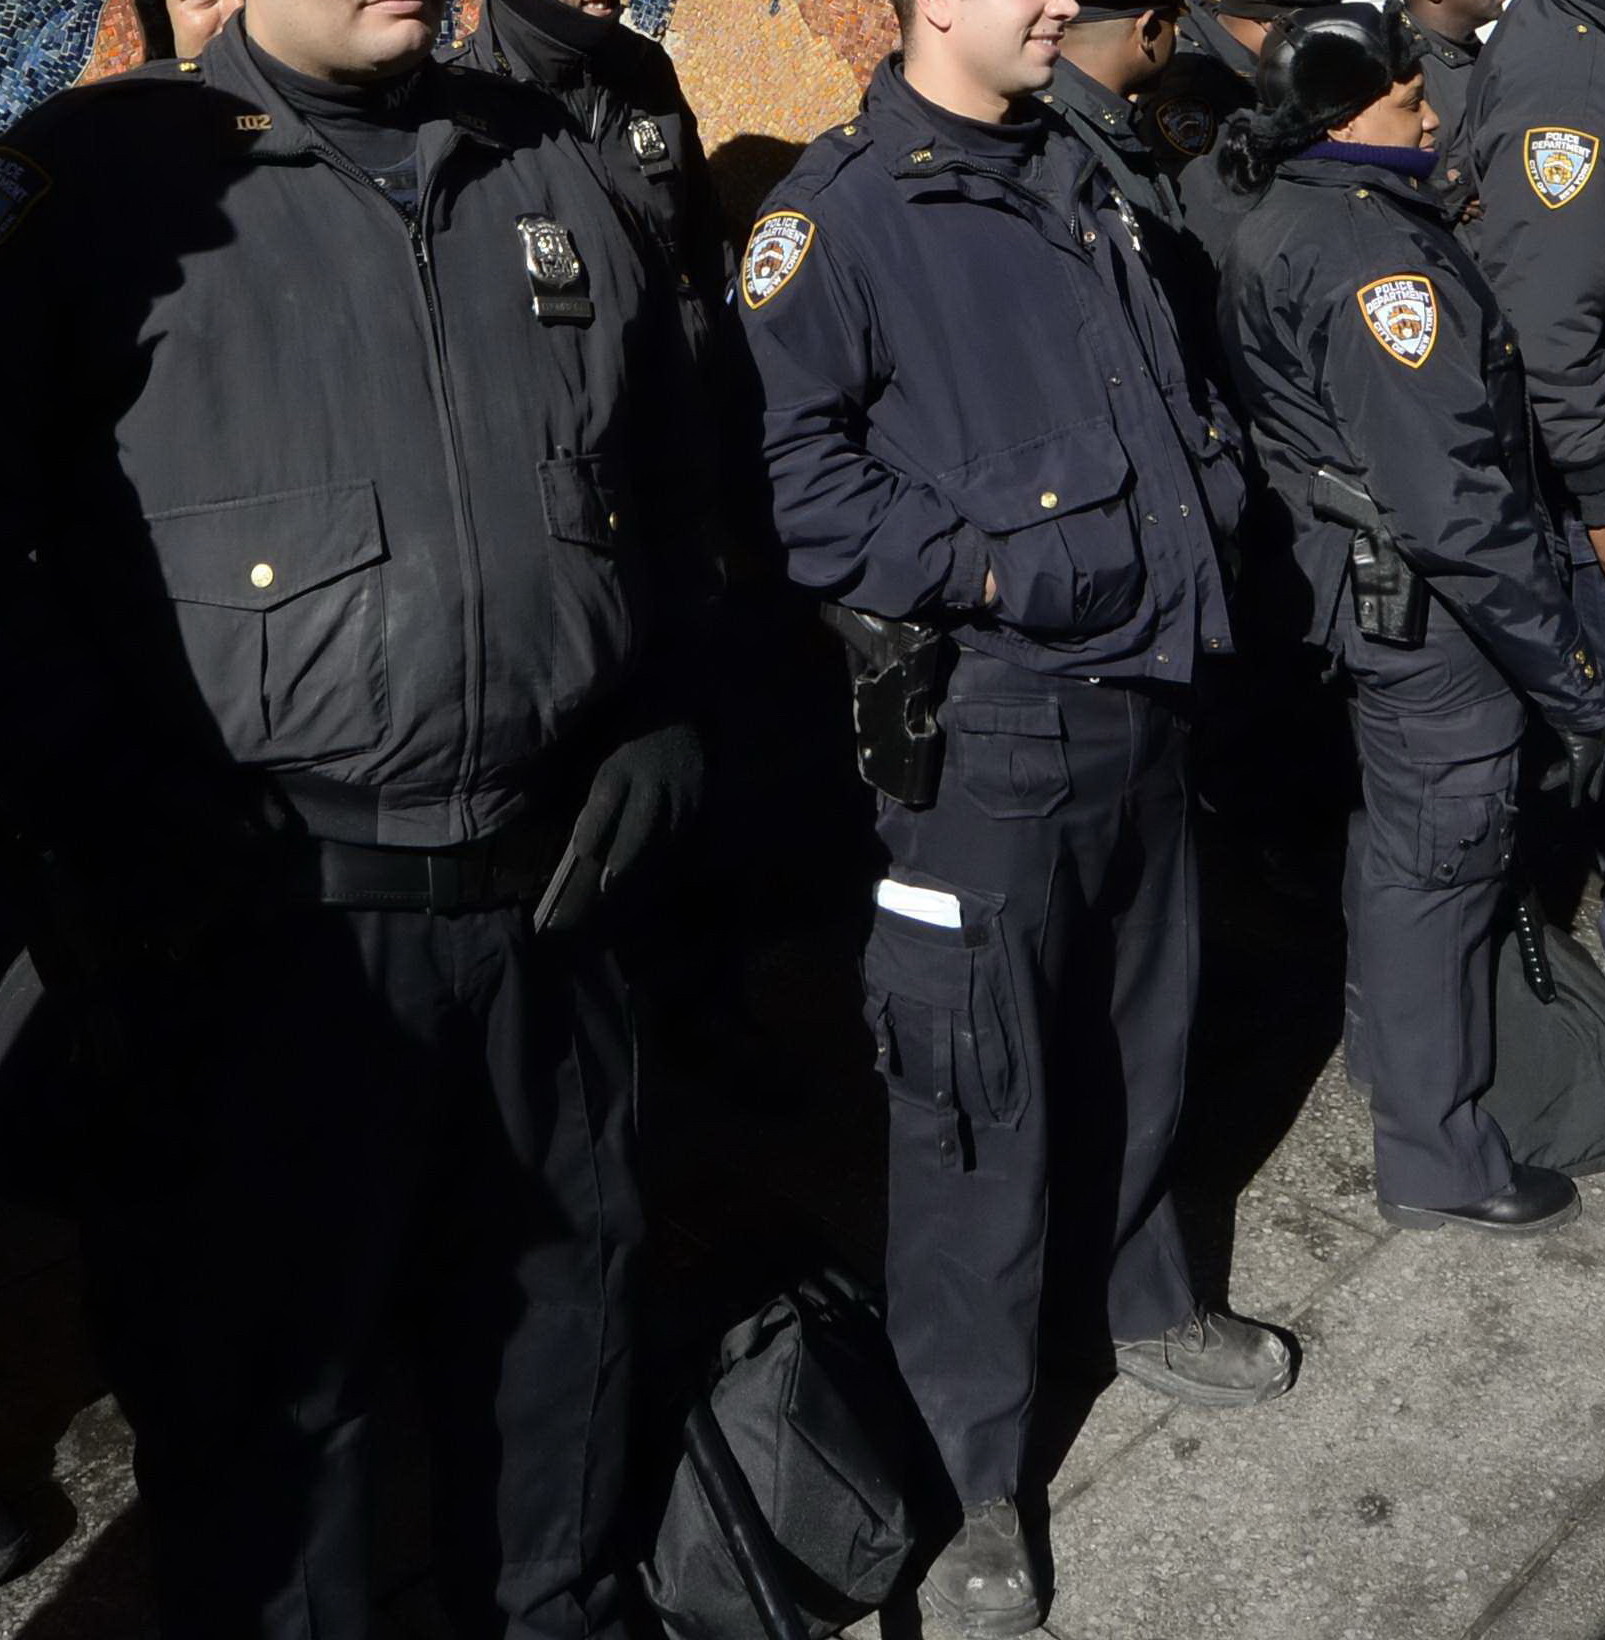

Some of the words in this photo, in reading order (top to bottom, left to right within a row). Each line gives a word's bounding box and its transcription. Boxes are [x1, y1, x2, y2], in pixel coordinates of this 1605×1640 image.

[236, 114, 272, 130] 102
[1545, 132, 1579, 145] POLICE
[1532, 140, 1592, 158] DEPARTMENT
[764, 216, 799, 233] POLICE
[1374, 281, 1415, 297] POLICE
[1366, 290, 1429, 315] DEPARTMENT
